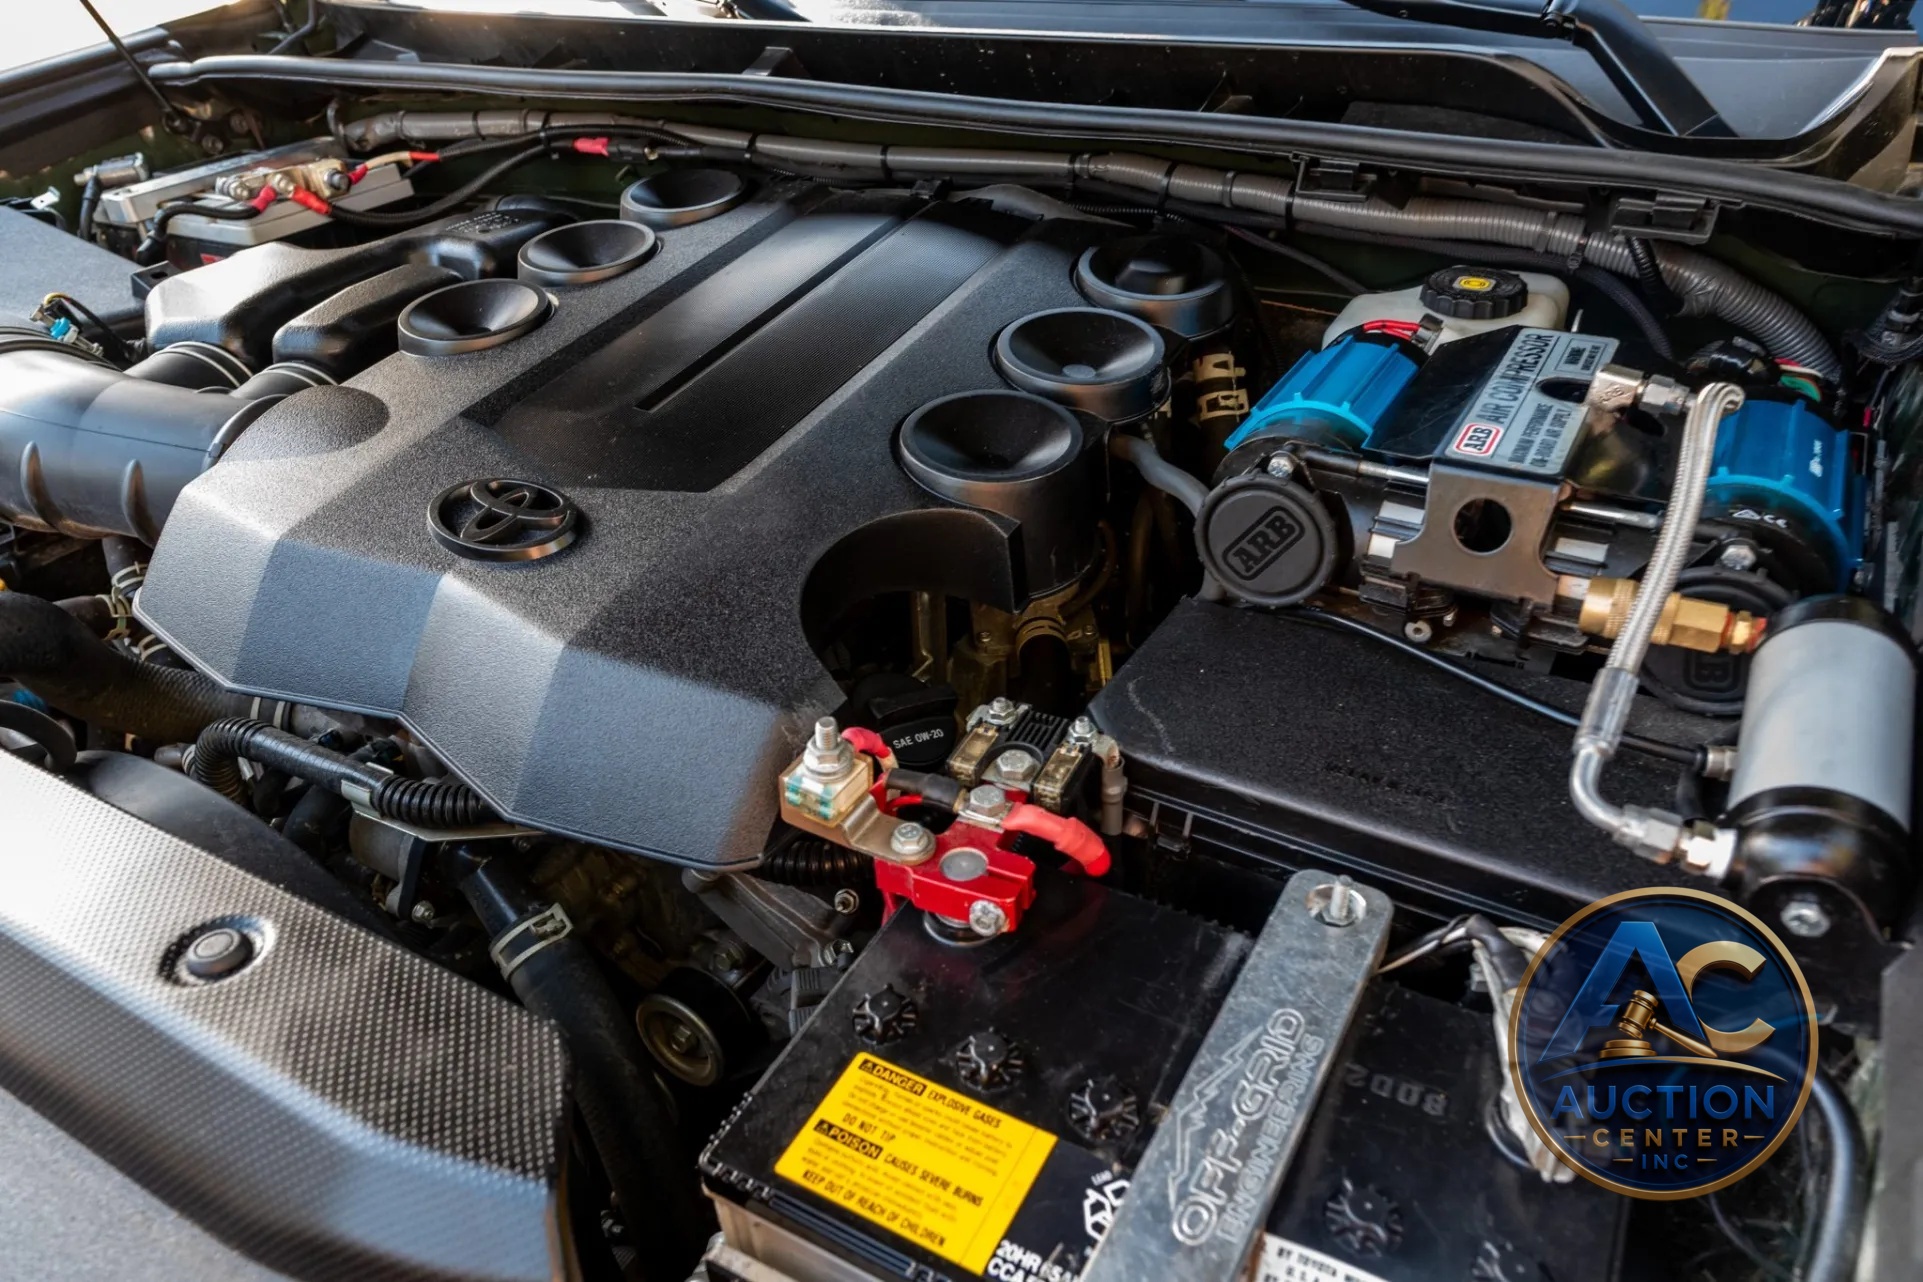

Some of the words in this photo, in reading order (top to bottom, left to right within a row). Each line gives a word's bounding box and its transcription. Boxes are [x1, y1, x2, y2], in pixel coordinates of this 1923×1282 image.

[1488, 333, 1554, 401] COMPRESSOR
[1463, 427, 1493, 452] ARB
[1475, 402, 1515, 426] AIR
[1232, 515, 1296, 573] ARB
[893, 736, 914, 749] SAE
[914, 728, 945, 743] 0W-20
[842, 1112, 857, 1126] DO
[858, 1120, 878, 1135] NOT
[880, 1130, 896, 1142] TIP
[872, 1063, 926, 1096] DANGER
[926, 1089, 973, 1116] EXPLOSIVE
[972, 1110, 1003, 1129] GASES
[1171, 1007, 1306, 1246] OFF-GRID
[828, 1127, 881, 1159] POISON
[884, 1153, 919, 1176] CAUSES
[918, 1169, 953, 1191] SEVERE
[952, 1186, 984, 1208] BURNS
[1216, 1033, 1325, 1245] ENGINEERING
[802, 1169, 826, 1185] KEEP
[824, 1180, 844, 1195] OUT
[843, 1188, 856, 1201] OF
[857, 1196, 887, 1216] REACH
[886, 1209, 900, 1222] OF
[899, 1217, 947, 1248] CHILDREN
